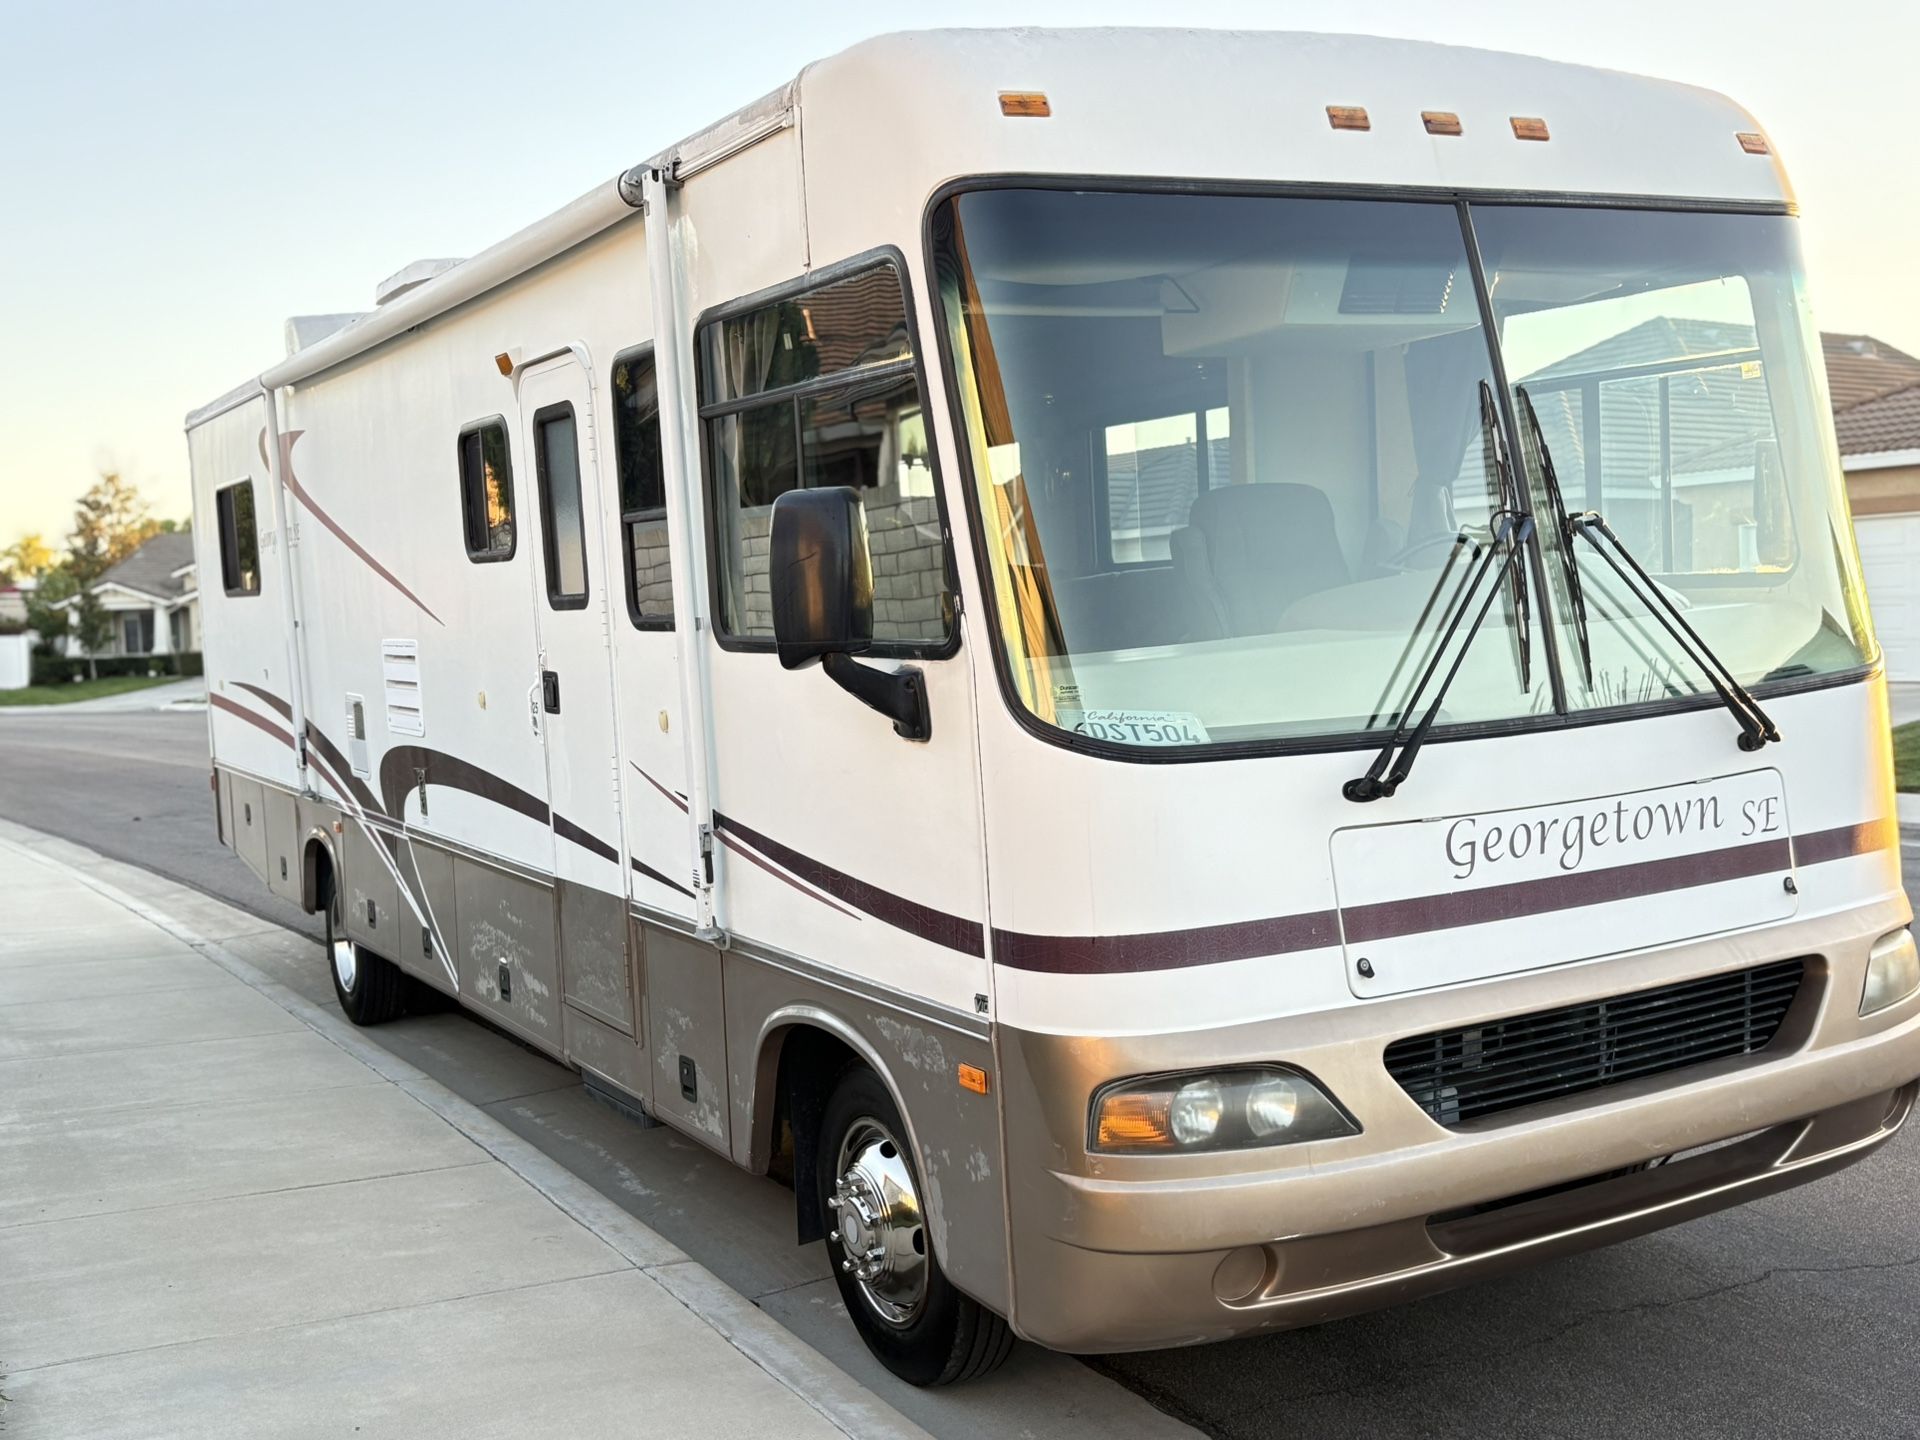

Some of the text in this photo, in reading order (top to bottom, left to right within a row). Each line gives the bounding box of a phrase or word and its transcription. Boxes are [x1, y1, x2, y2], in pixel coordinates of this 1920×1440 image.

[1087, 711, 1167, 723] California
[1446, 796, 1779, 879] Georgetown SE
